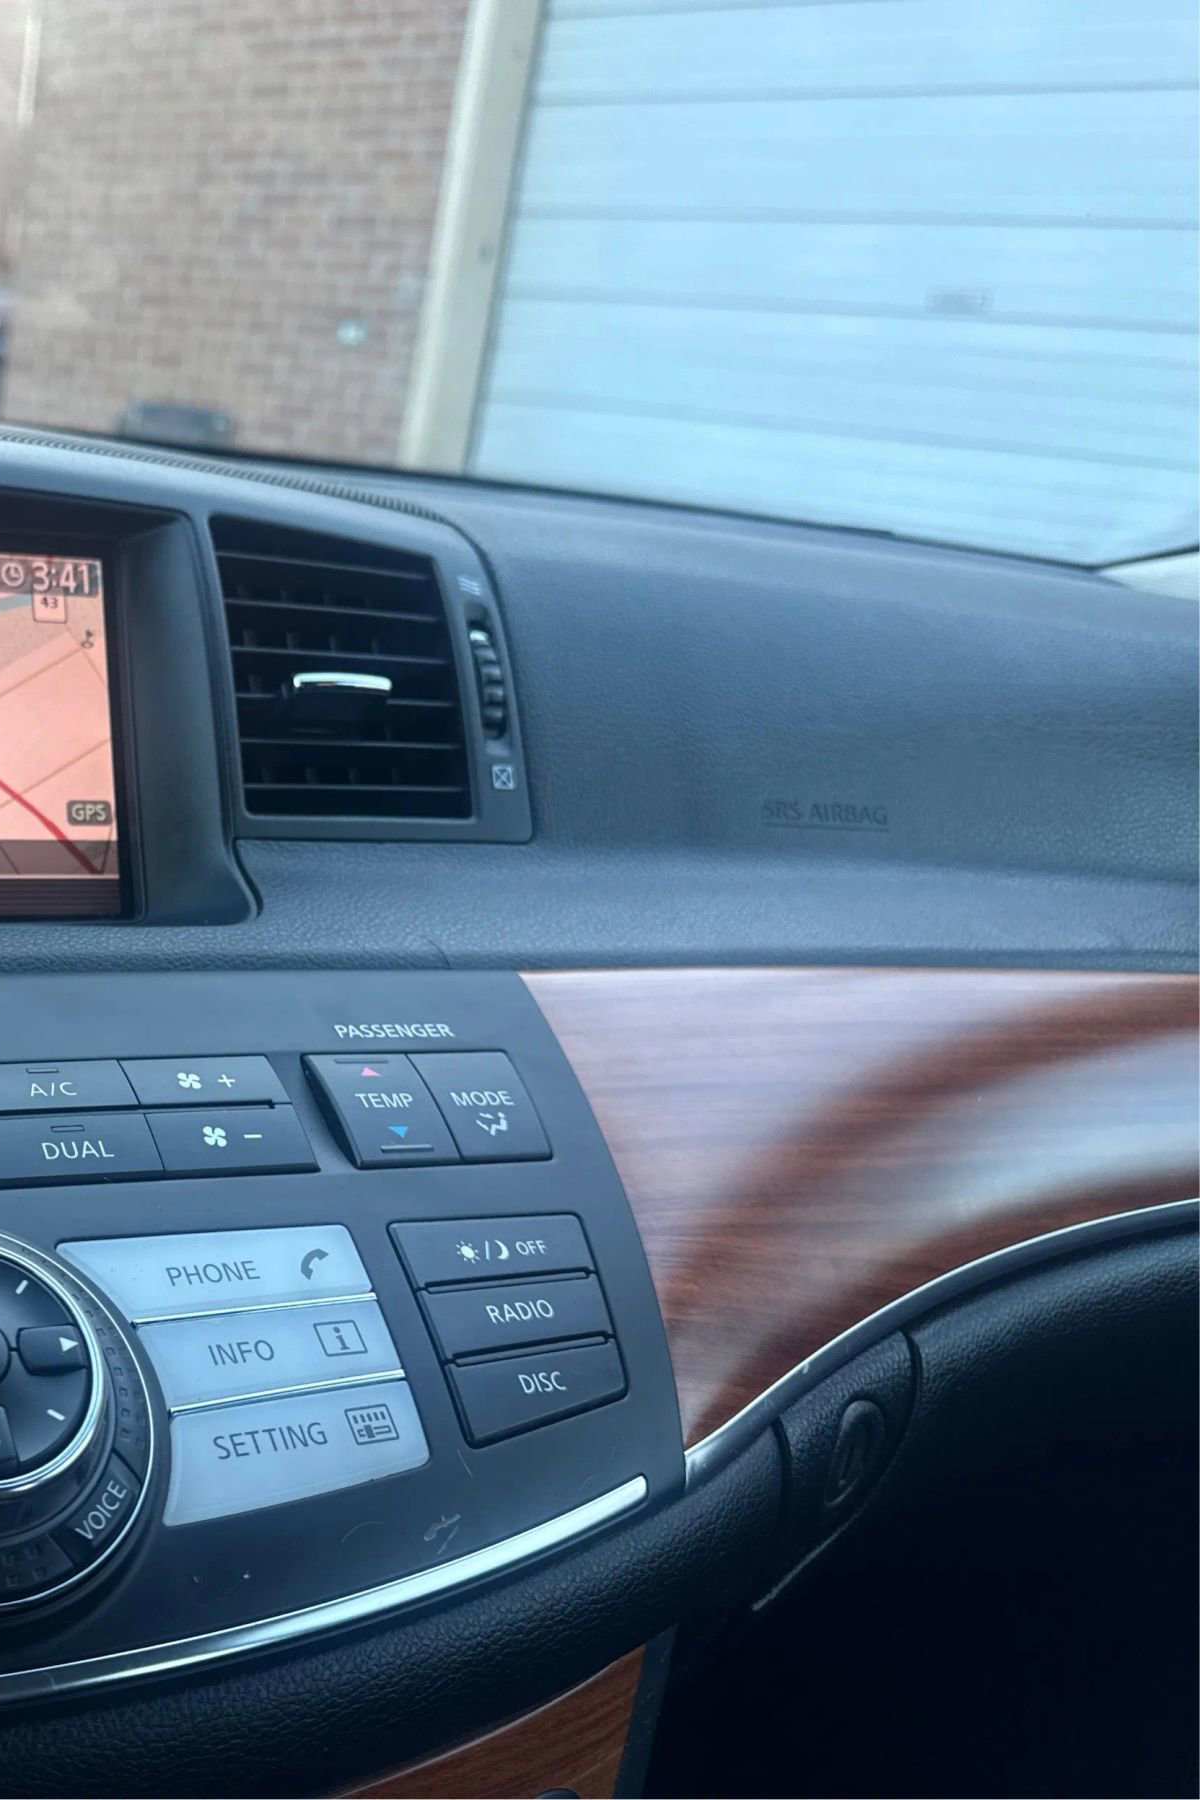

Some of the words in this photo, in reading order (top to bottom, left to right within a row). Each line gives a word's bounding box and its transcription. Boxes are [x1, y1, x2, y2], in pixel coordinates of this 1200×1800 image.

[31, 560, 91, 594] 3:41
[40, 597, 59, 610] 43
[71, 803, 107, 821] GPS
[762, 801, 801, 821] SRS
[809, 803, 889, 826] AIRBAG
[334, 1023, 456, 1040] PASSENGER
[30, 1081, 78, 1098] A/C
[450, 1090, 516, 1108] MODE
[355, 1092, 414, 1109] TEMP
[41, 1140, 115, 1160] DUAL
[515, 1239, 548, 1257] OFF
[166, 1259, 261, 1288] PHONE
[485, 1299, 555, 1326] RADIO
[207, 1339, 276, 1367] INFO
[518, 1371, 568, 1394] DISC
[213, 1422, 329, 1460] SETTING
[74, 1478, 127, 1542] VOICE
